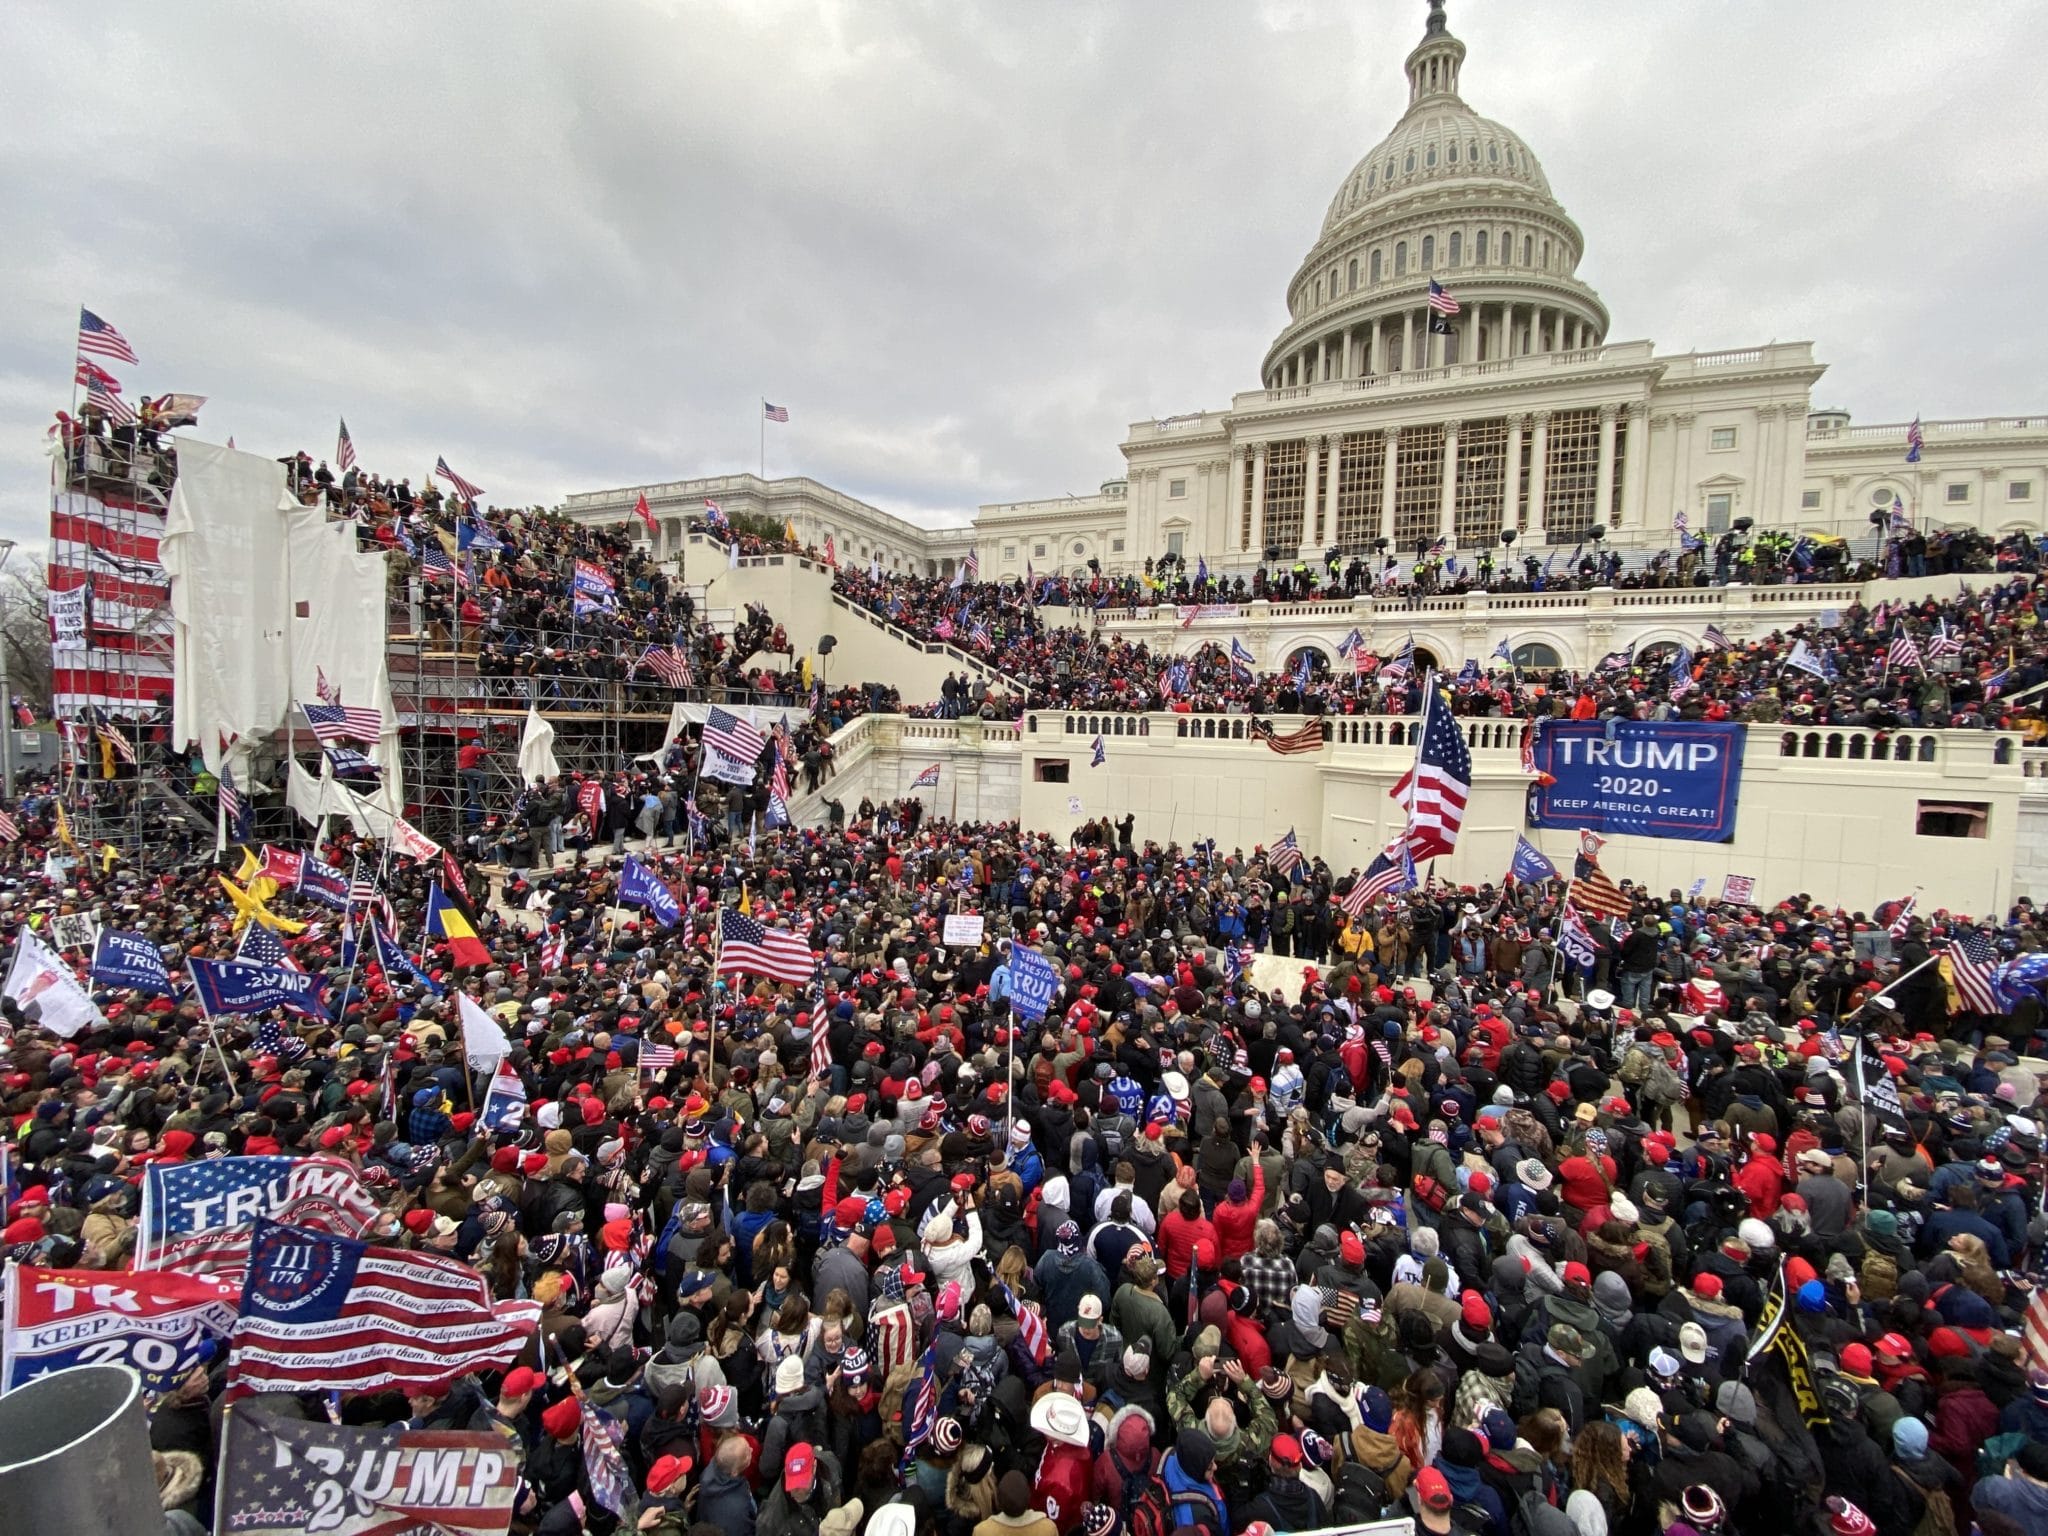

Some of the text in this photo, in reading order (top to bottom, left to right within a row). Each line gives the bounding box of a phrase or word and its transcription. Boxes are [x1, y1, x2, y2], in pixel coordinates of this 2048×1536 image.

[1555, 736, 1718, 771] TRUMP
[1553, 798, 1588, 809] KEEP
[1658, 806, 1715, 819] GREAT!
[624, 888, 642, 897] FUCK
[53, 914, 86, 928] FUCK
[61, 924, 84, 934] THE
[61, 932, 92, 946] NWO
[123, 952, 170, 979] TRUM
[1020, 951, 1048, 966] THAN
[211, 962, 312, 993] TUMP
[180, 1168, 375, 1232] TRUMP
[172, 1232, 235, 1253] MAKING
[292, 1201, 329, 1219] GREAT
[271, 1244, 314, 1271] III
[269, 1270, 303, 1285] 1776
[365, 1261, 405, 1274] armed
[406, 1267, 432, 1280] and
[263, 1294, 312, 1311] BECOMES
[354, 1286, 395, 1301] should
[395, 1292, 422, 1312] have
[31, 1317, 109, 1349] KEEP
[283, 1326, 296, 1336] to
[300, 1320, 355, 1337] maintain
[370, 1318, 406, 1334] status
[408, 1328, 424, 1338] of
[425, 1325, 501, 1343] independence
[251, 1350, 289, 1365] might
[347, 1352, 358, 1362] to
[361, 1346, 394, 1359] abuse
[841, 1351, 868, 1369] RUM
